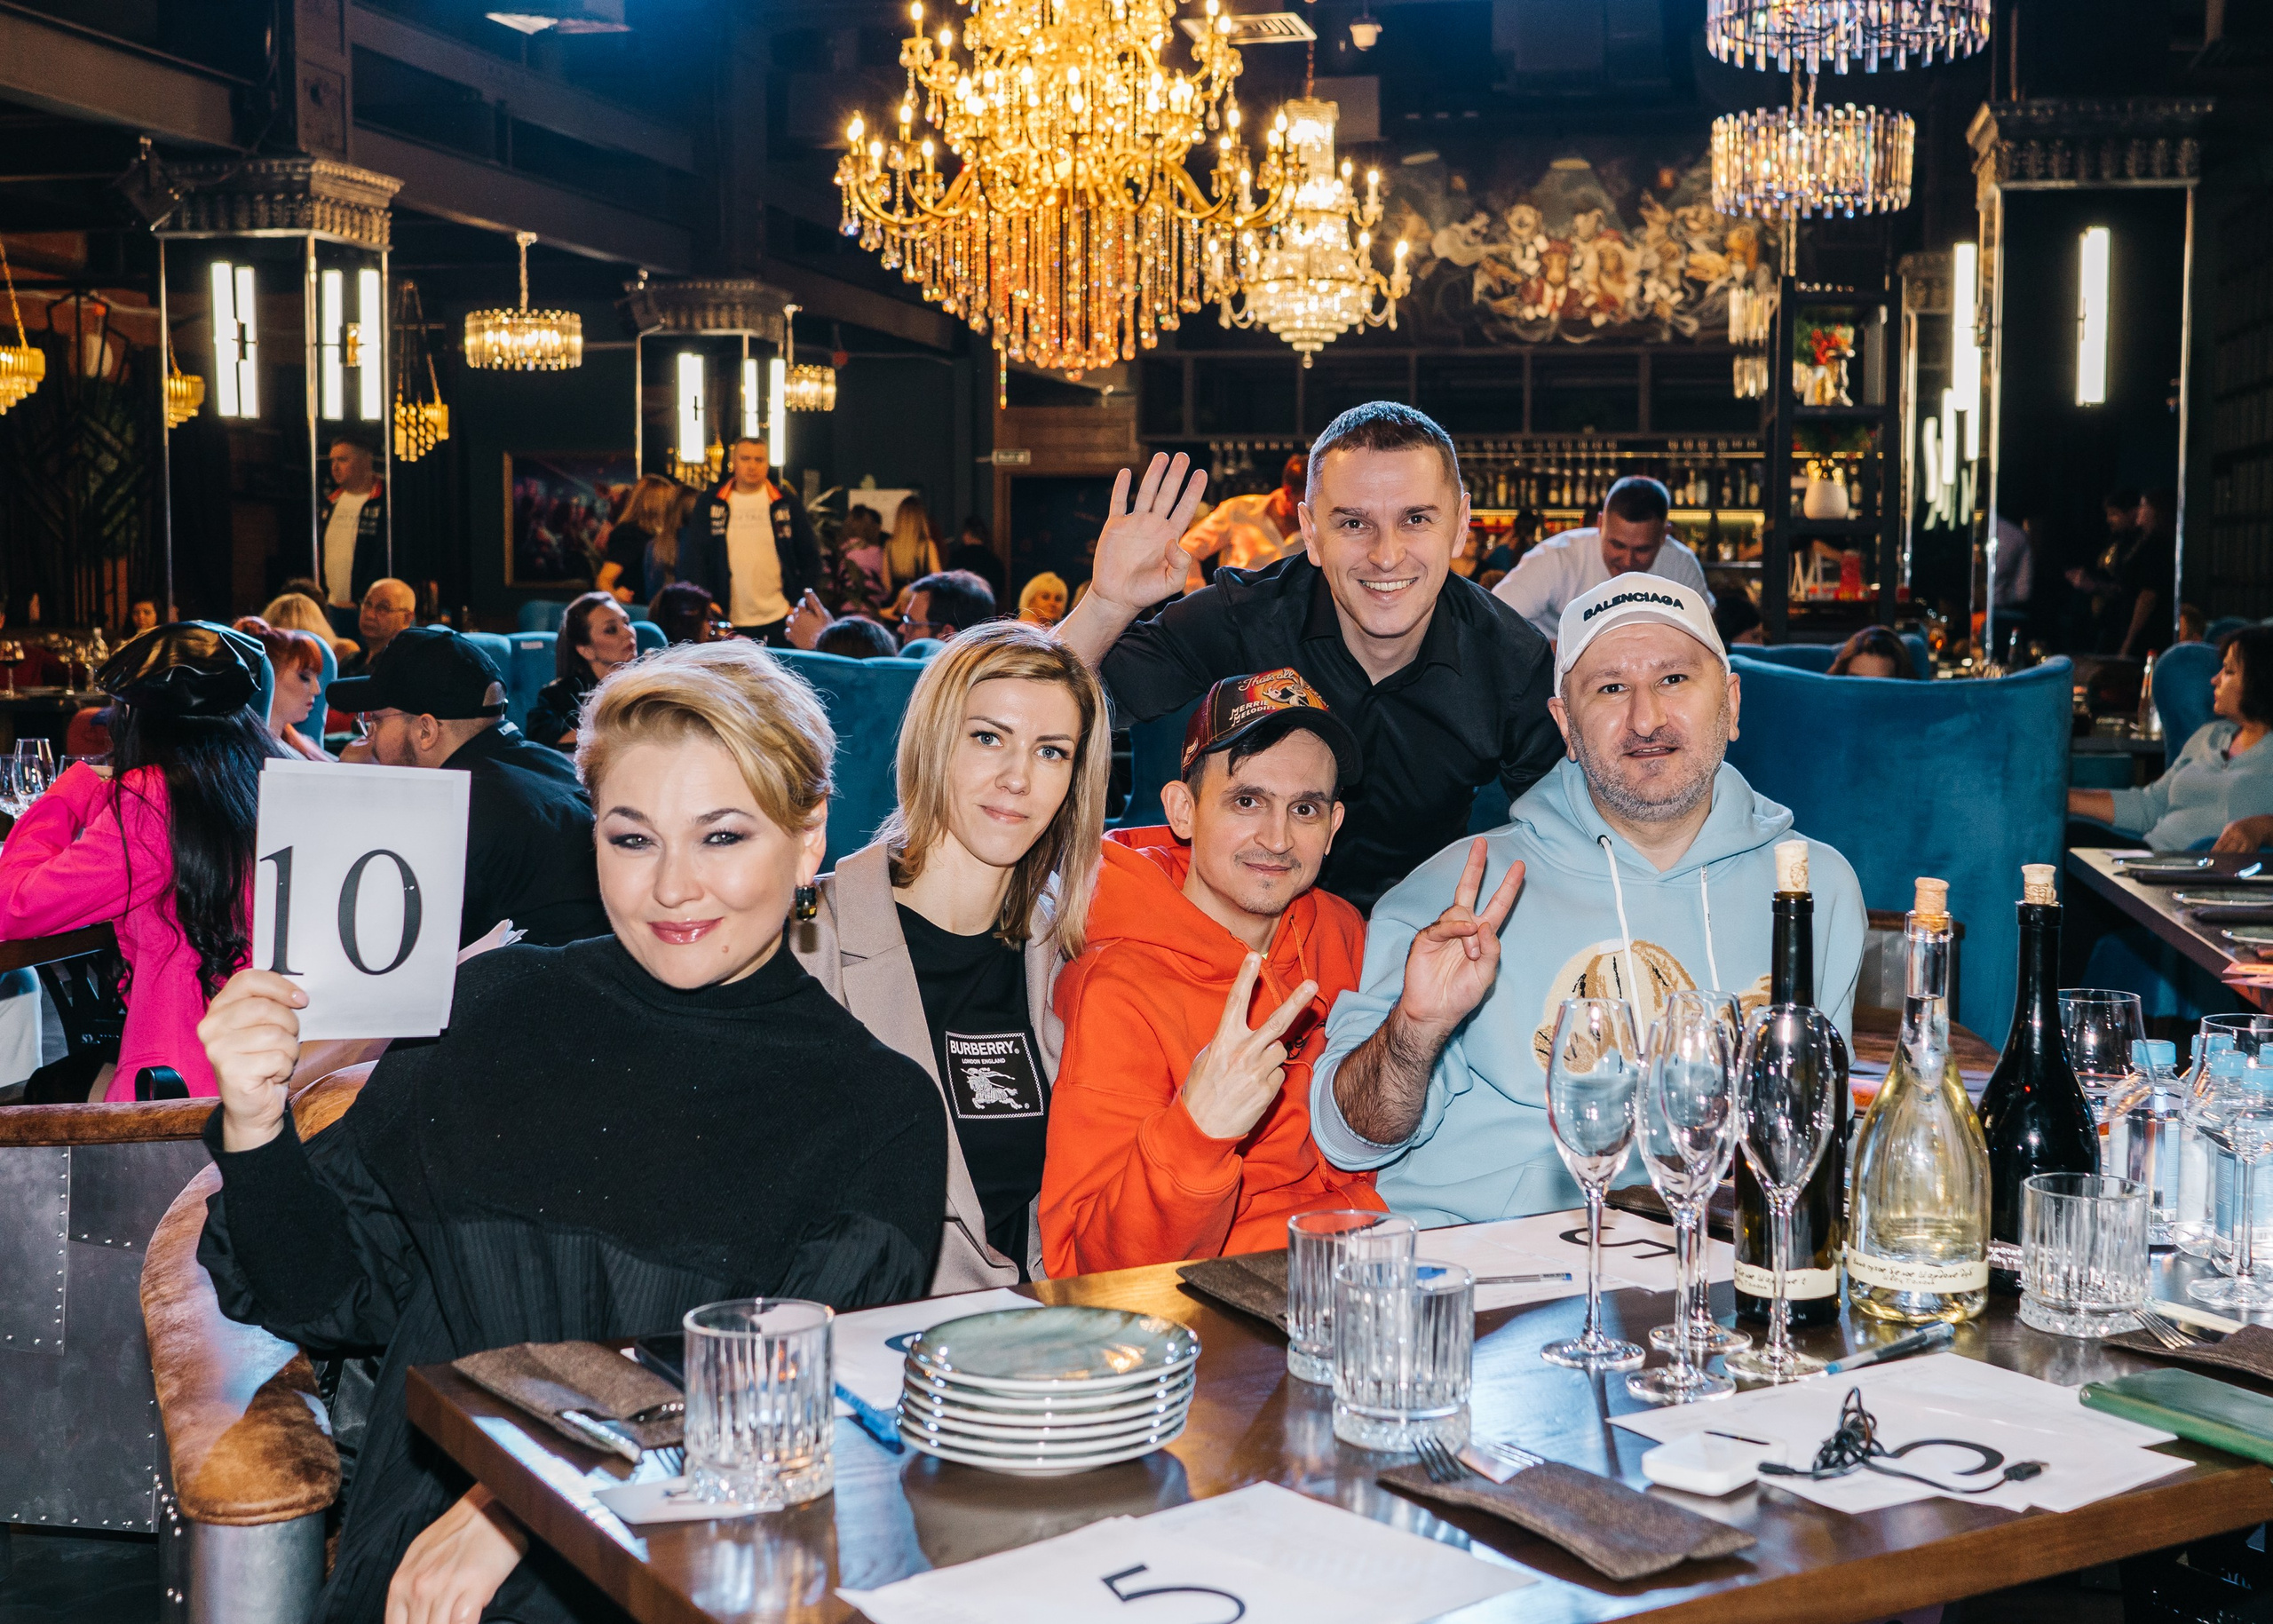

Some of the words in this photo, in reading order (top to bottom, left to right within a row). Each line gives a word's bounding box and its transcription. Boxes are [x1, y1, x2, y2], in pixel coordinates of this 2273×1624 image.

[1583, 592, 1684, 622] BALENCIAGA
[1276, 668, 1296, 680] all
[1229, 701, 1269, 720] MERRIE
[1231, 705, 1276, 727] MELODIES
[259, 845, 423, 976] 10
[949, 1040, 1014, 1056] BURBERRY
[1102, 1564, 1246, 1624] 5
